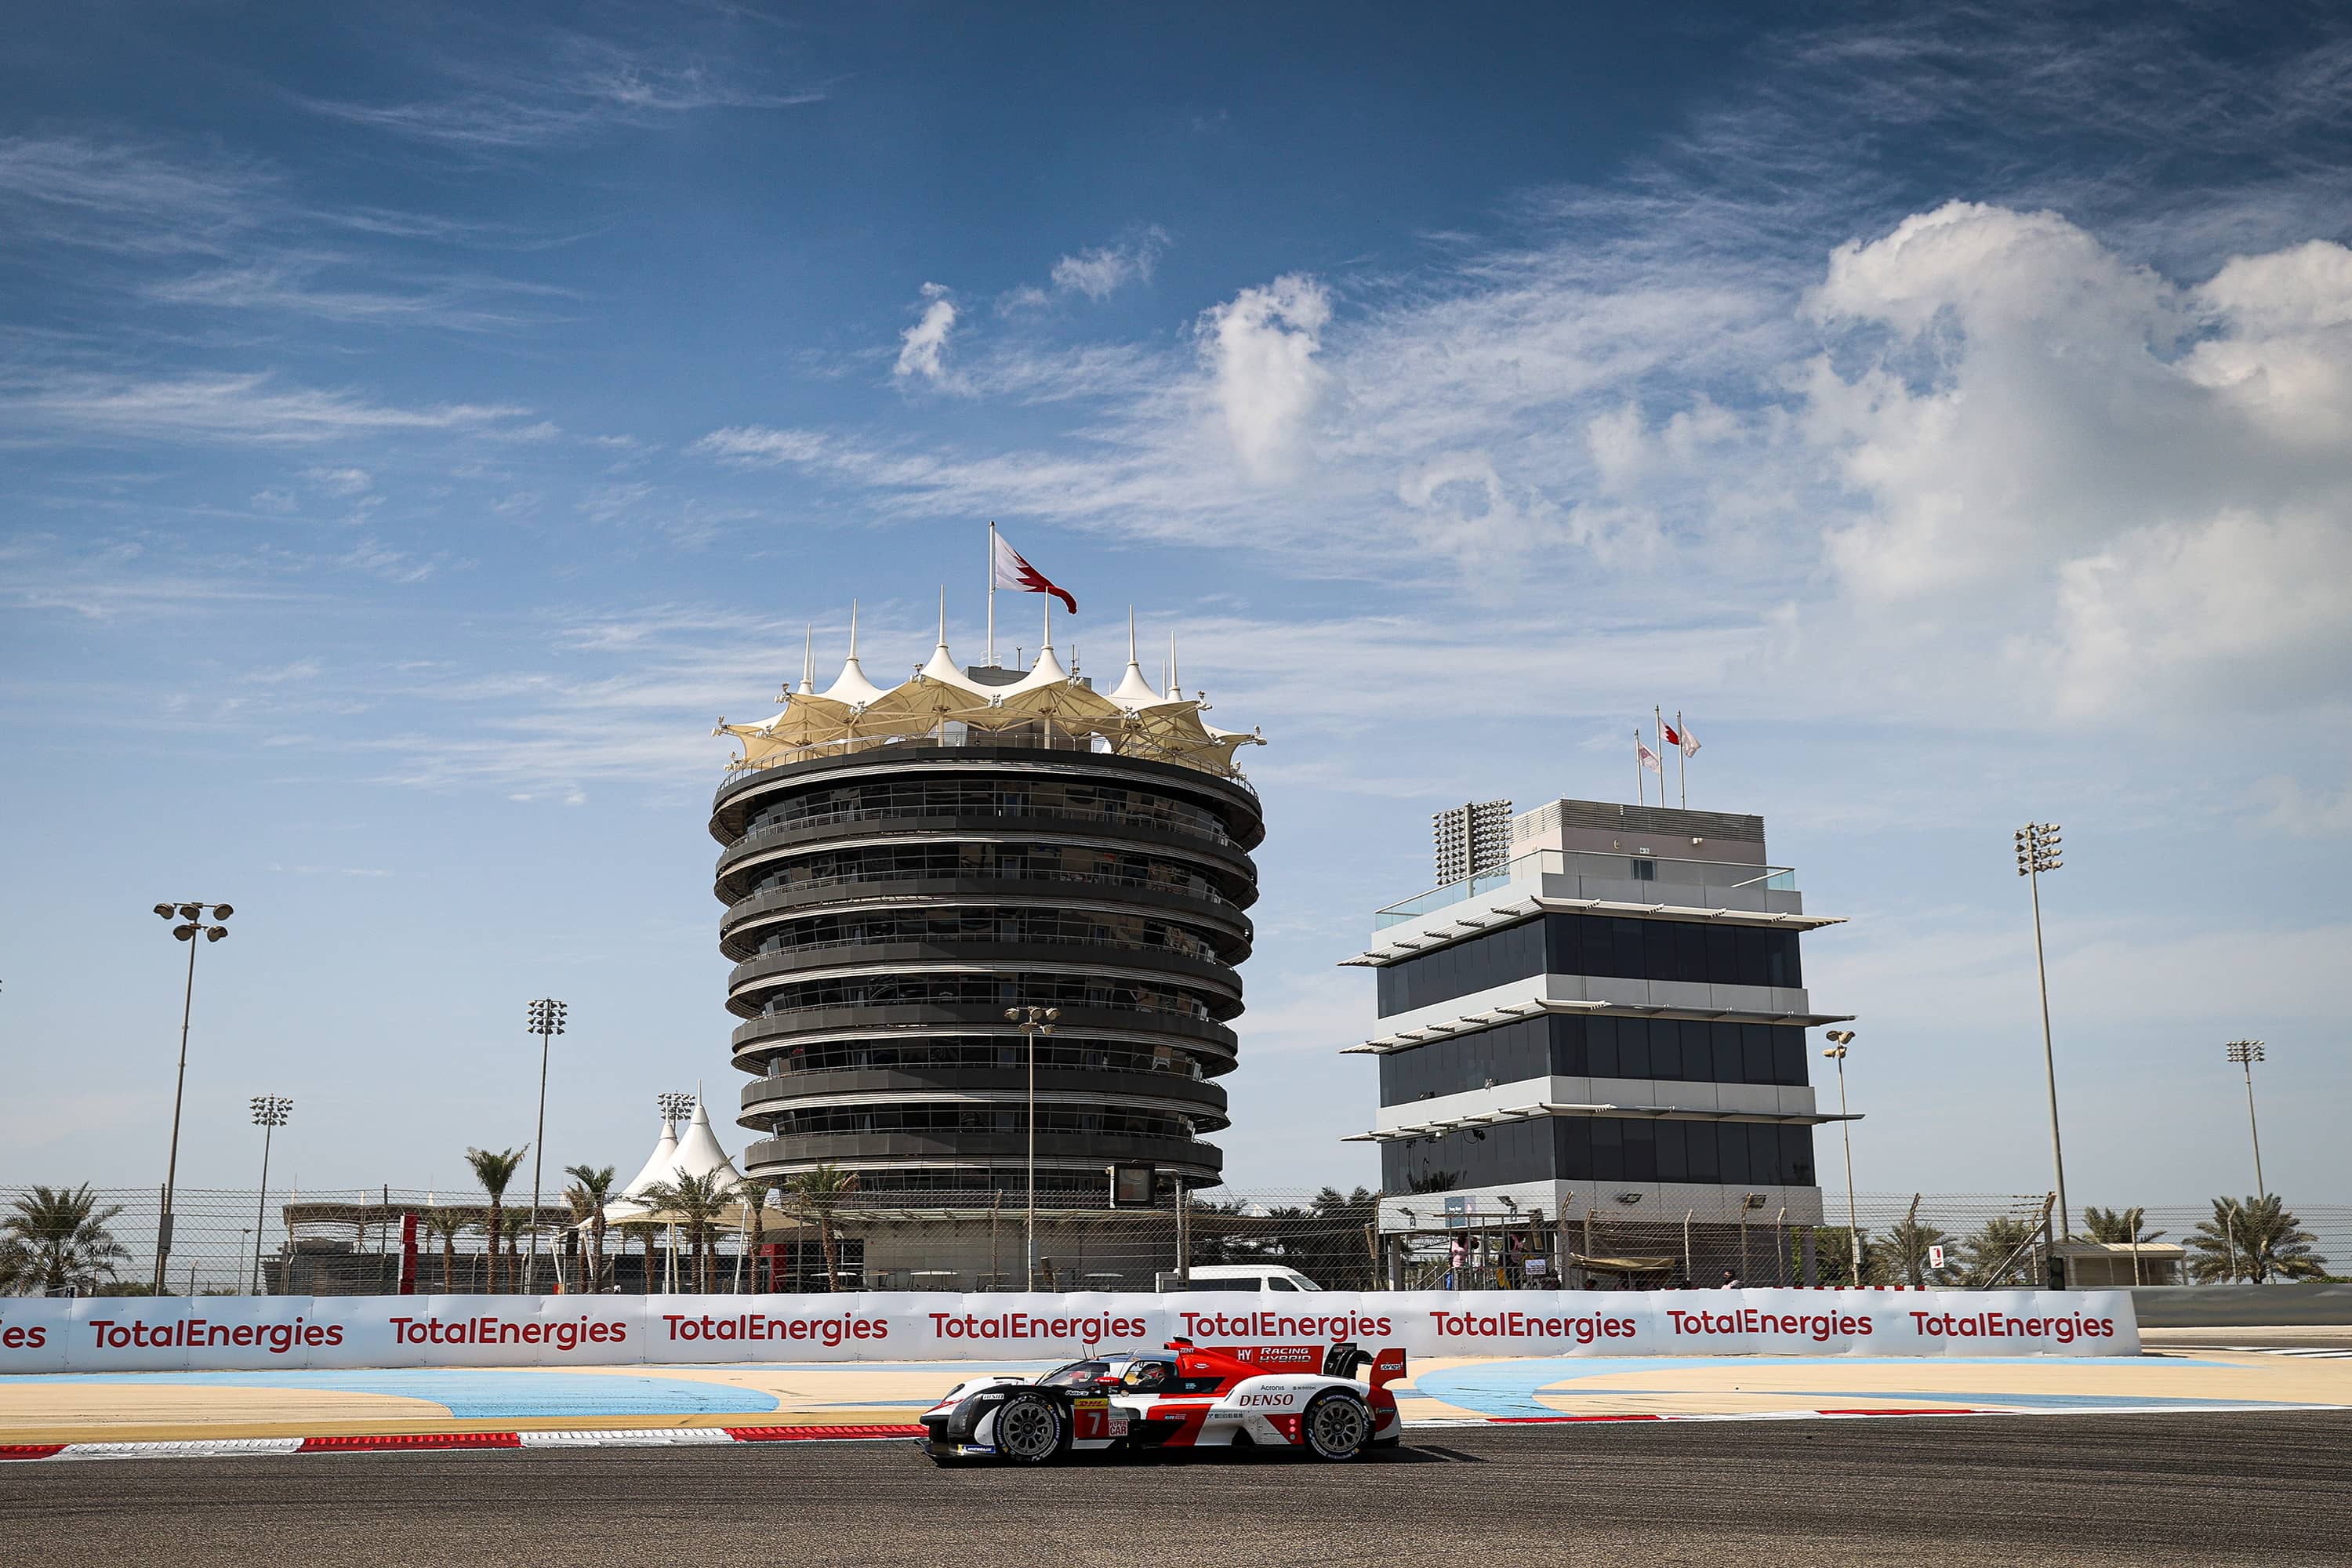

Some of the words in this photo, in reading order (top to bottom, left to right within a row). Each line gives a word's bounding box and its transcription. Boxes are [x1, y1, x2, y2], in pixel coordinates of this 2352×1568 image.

[92, 1318, 343, 1353] TotalEnergies
[390, 1316, 627, 1351] TotalEnergies
[664, 1313, 887, 1347] TotalEnergies
[929, 1312, 1146, 1345] TotalEnergies
[1180, 1310, 1392, 1343] TotalEnergies
[1429, 1311, 1635, 1344] TotalEnergies
[1668, 1308, 1872, 1341] TotalEnergies
[1910, 1311, 2114, 1343] TotalEnergies
[1238, 1349, 1251, 1360] HY
[1239, 1394, 1294, 1406] DENSO
[1087, 1412, 1101, 1436] 7
